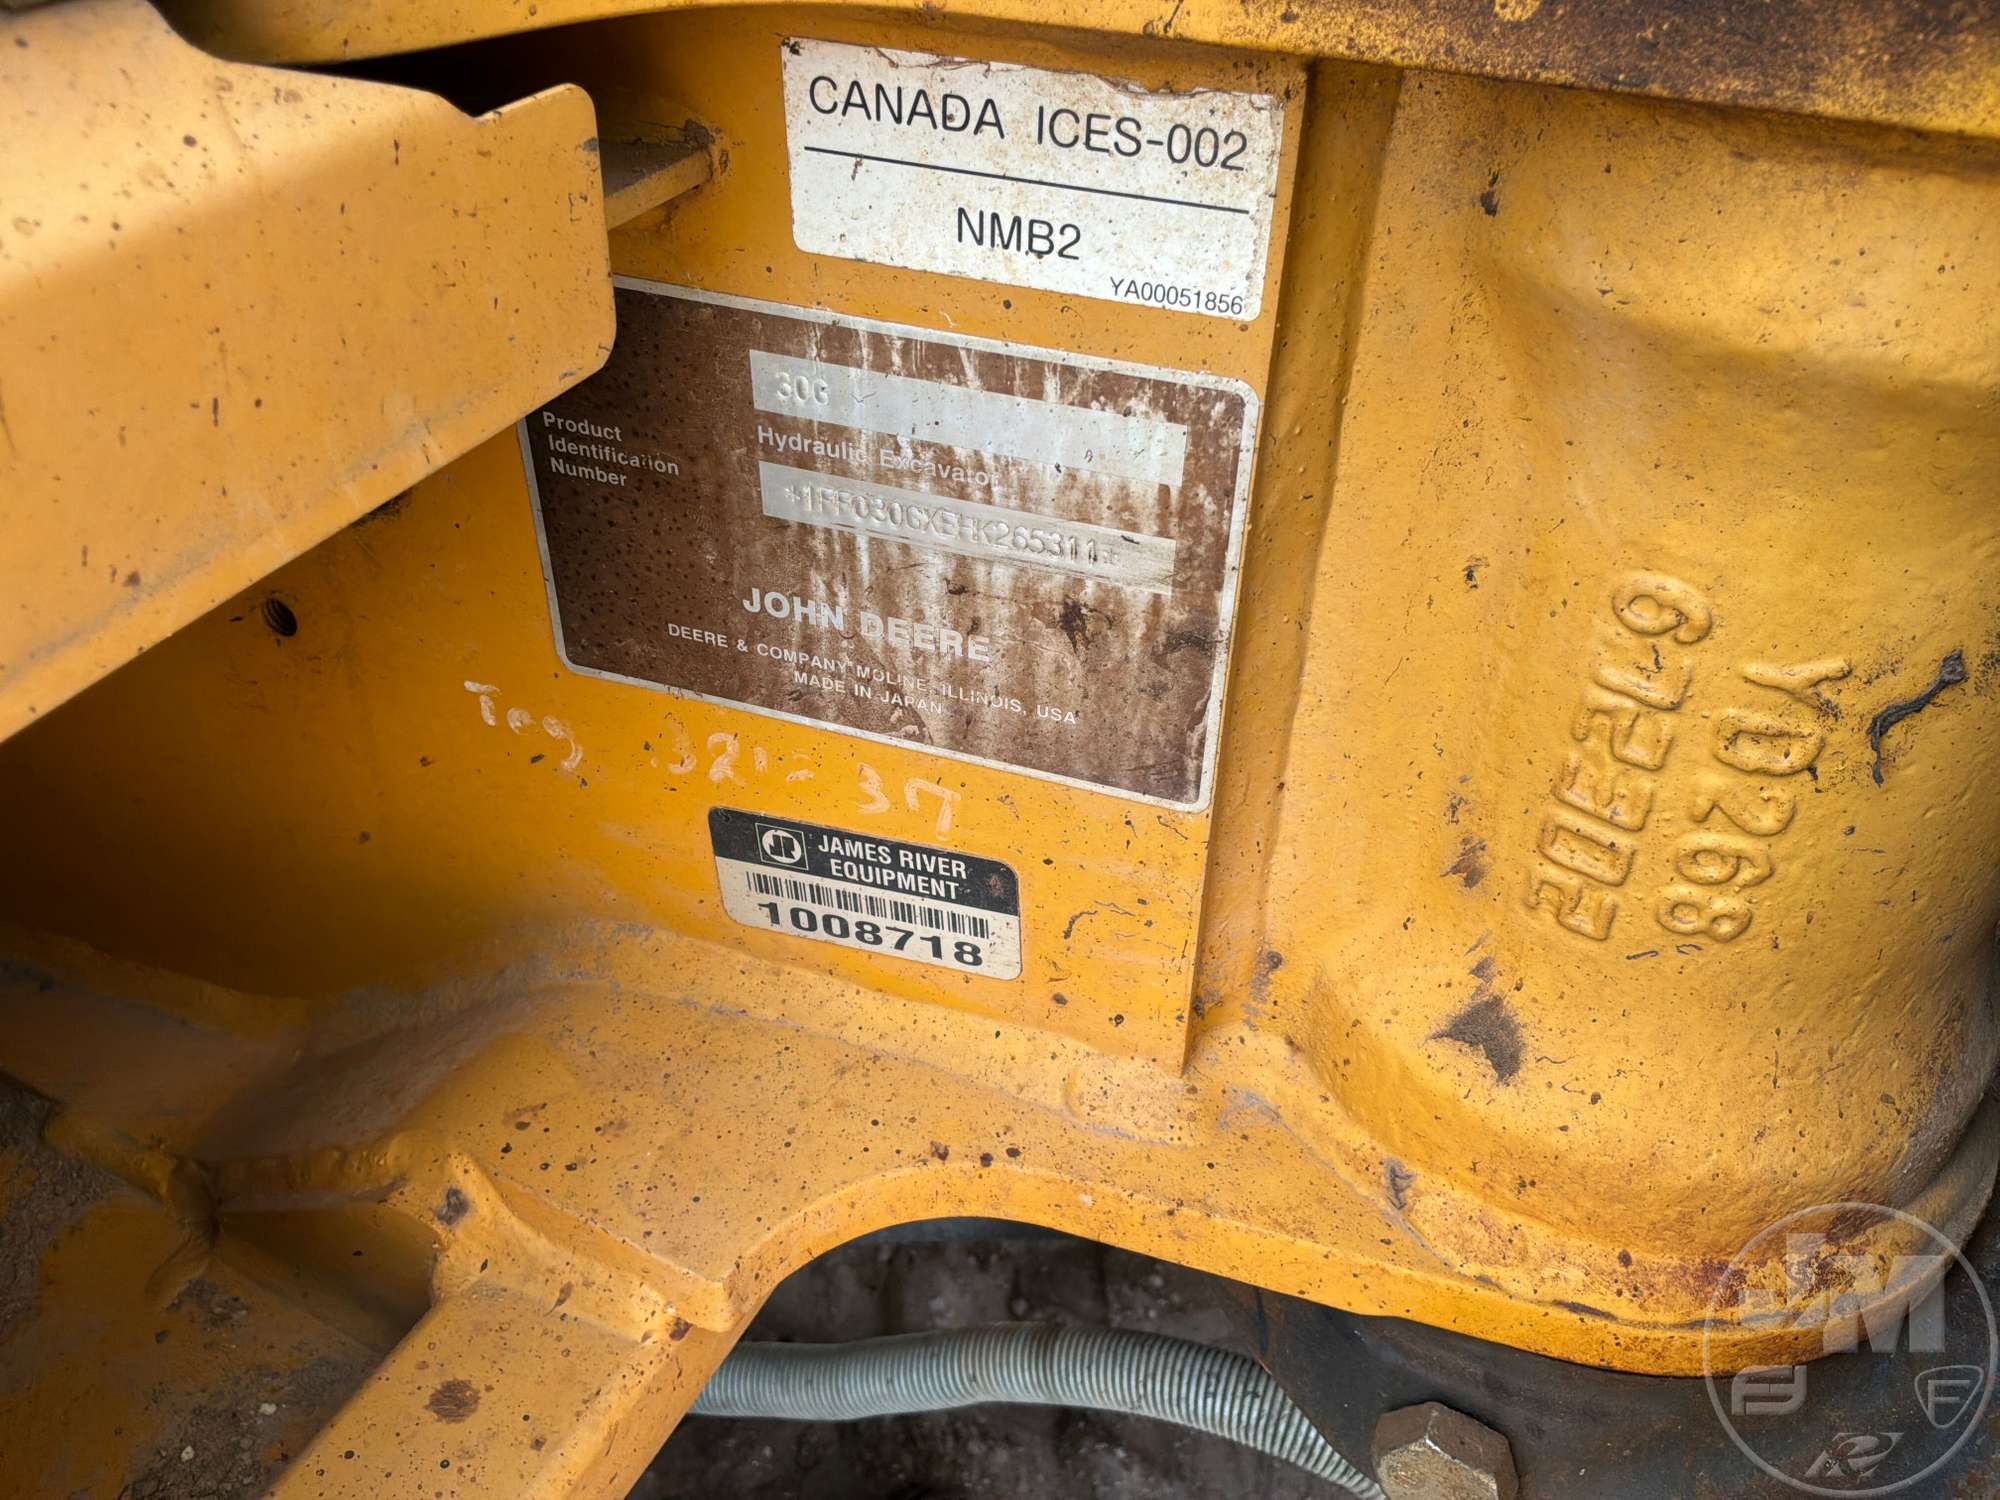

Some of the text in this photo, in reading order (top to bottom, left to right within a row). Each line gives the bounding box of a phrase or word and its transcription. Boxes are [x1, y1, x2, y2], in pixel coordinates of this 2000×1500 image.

[809, 75, 1248, 171] CANADA ICES-002
[957, 207, 1081, 260] NMB2
[1110, 276, 1244, 315] YA00051856
[543, 411, 622, 441] Product
[549, 435, 680, 476] Identification
[551, 458, 626, 487] Number
[758, 424, 1000, 487] Hydraulic Excavator
[742, 587, 992, 662] JOHN DEERE
[667, 623, 728, 648] DEERE
[737, 639, 749, 653] &
[1037, 705, 1076, 724] USA
[794, 670, 944, 714] MADE IN JAPAN
[818, 834, 967, 879] JAMES RIVER
[830, 859, 960, 900] EQUIPMENT
[758, 902, 983, 967] 1008718
